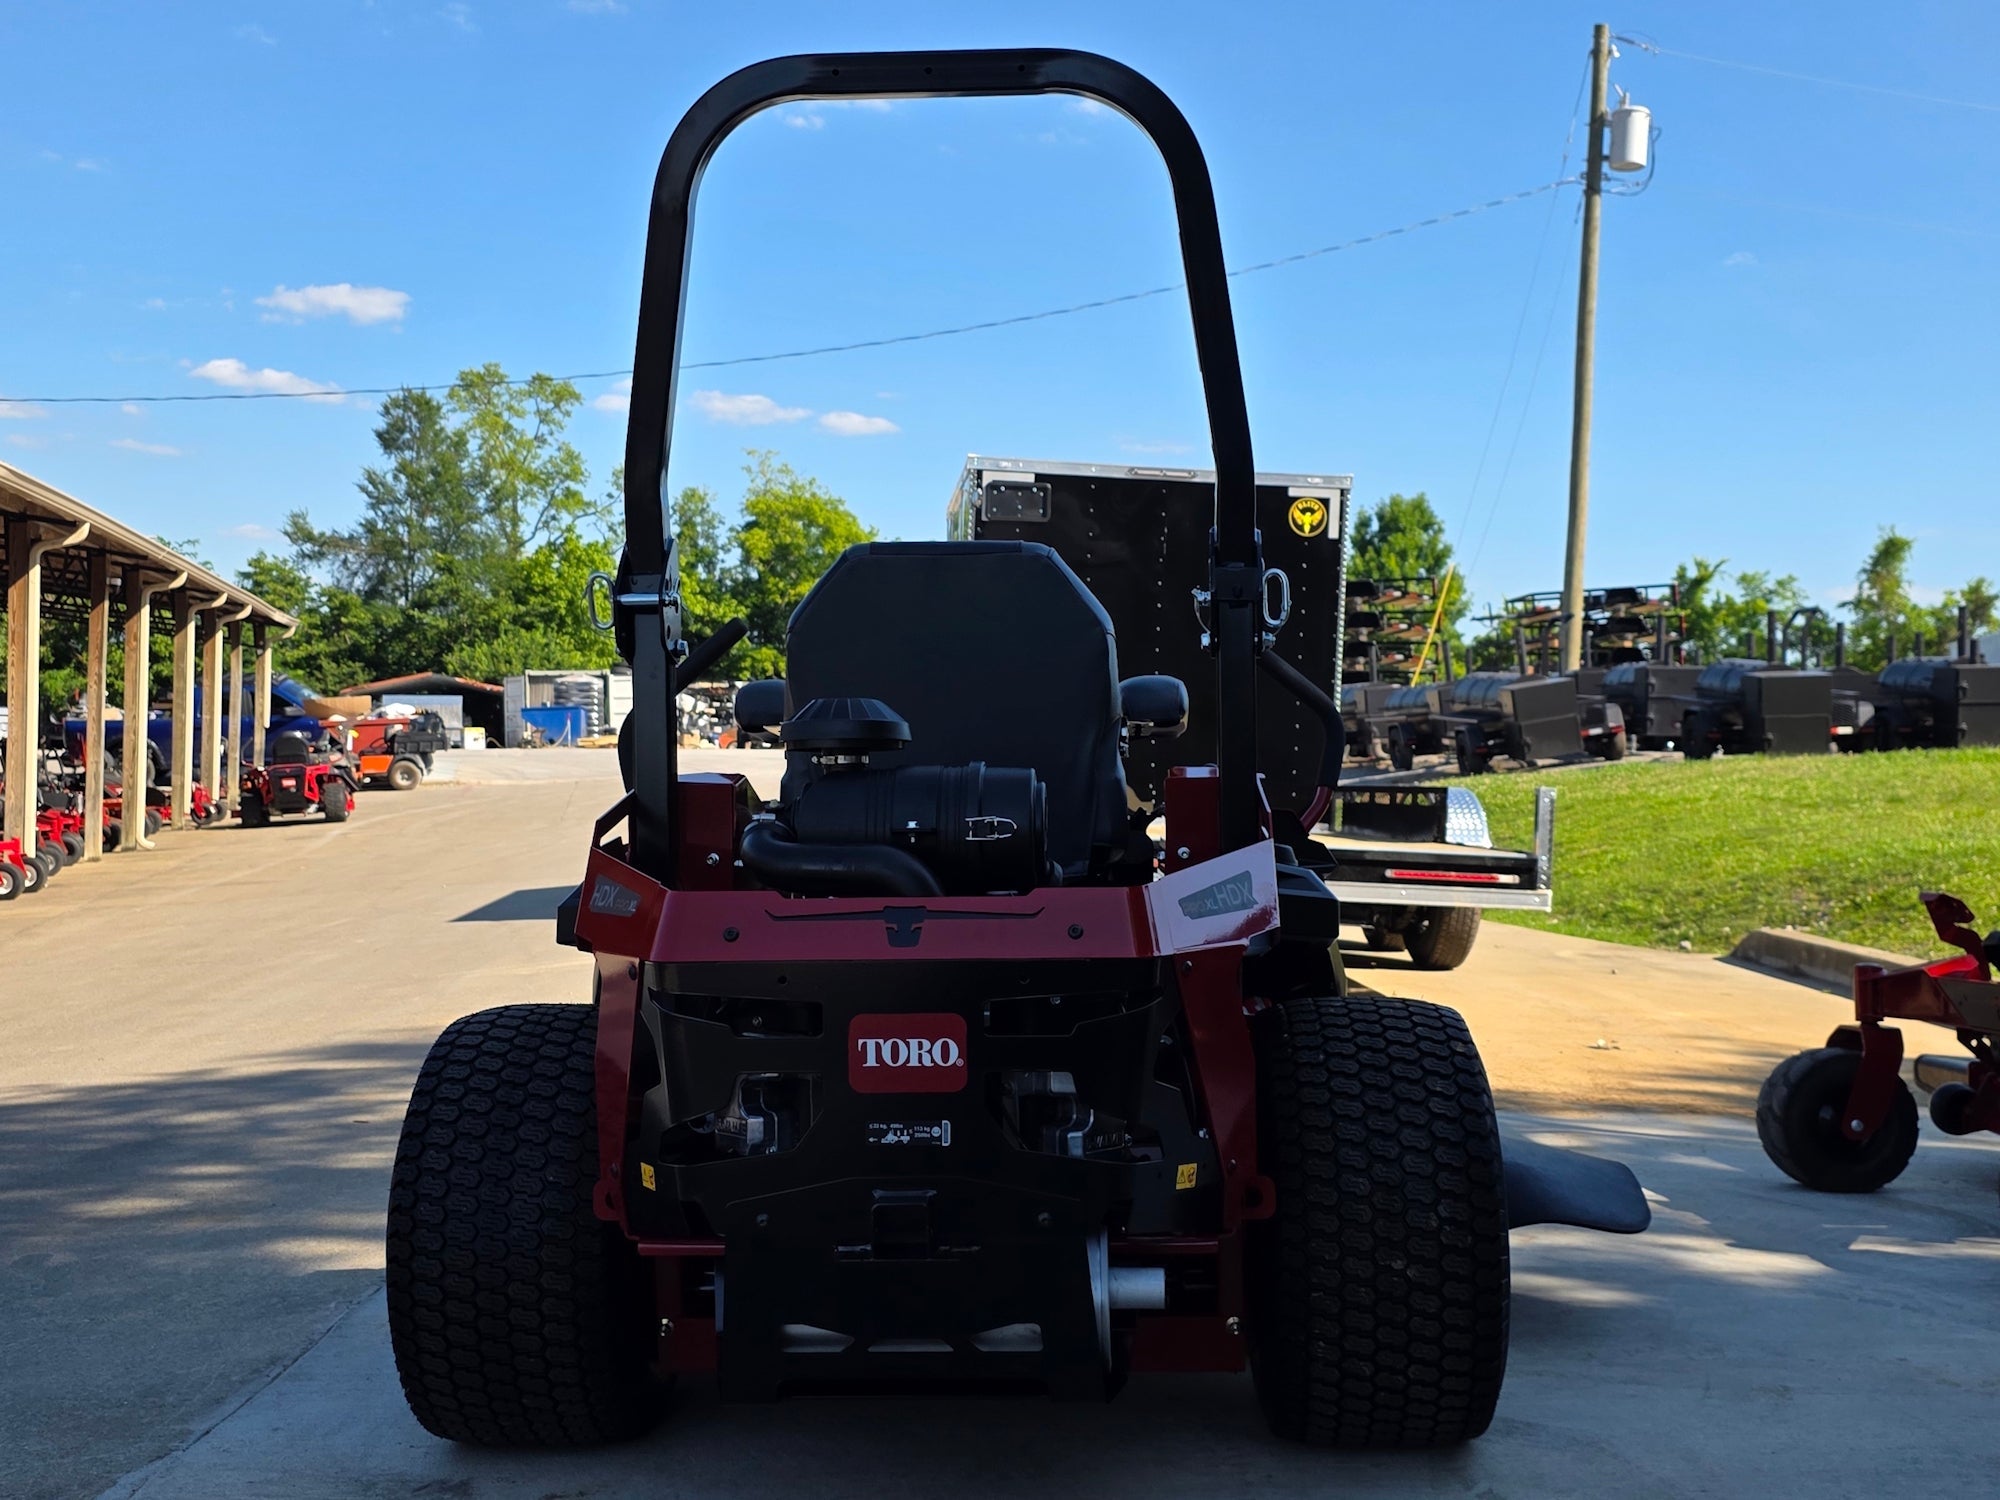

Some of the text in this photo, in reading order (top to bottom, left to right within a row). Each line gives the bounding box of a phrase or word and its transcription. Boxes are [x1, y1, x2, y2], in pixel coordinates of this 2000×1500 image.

[590, 884, 620, 908] HDX
[1205, 897, 1219, 911] XL
[1213, 881, 1257, 908] HDX
[858, 1038, 960, 1067] TORO
